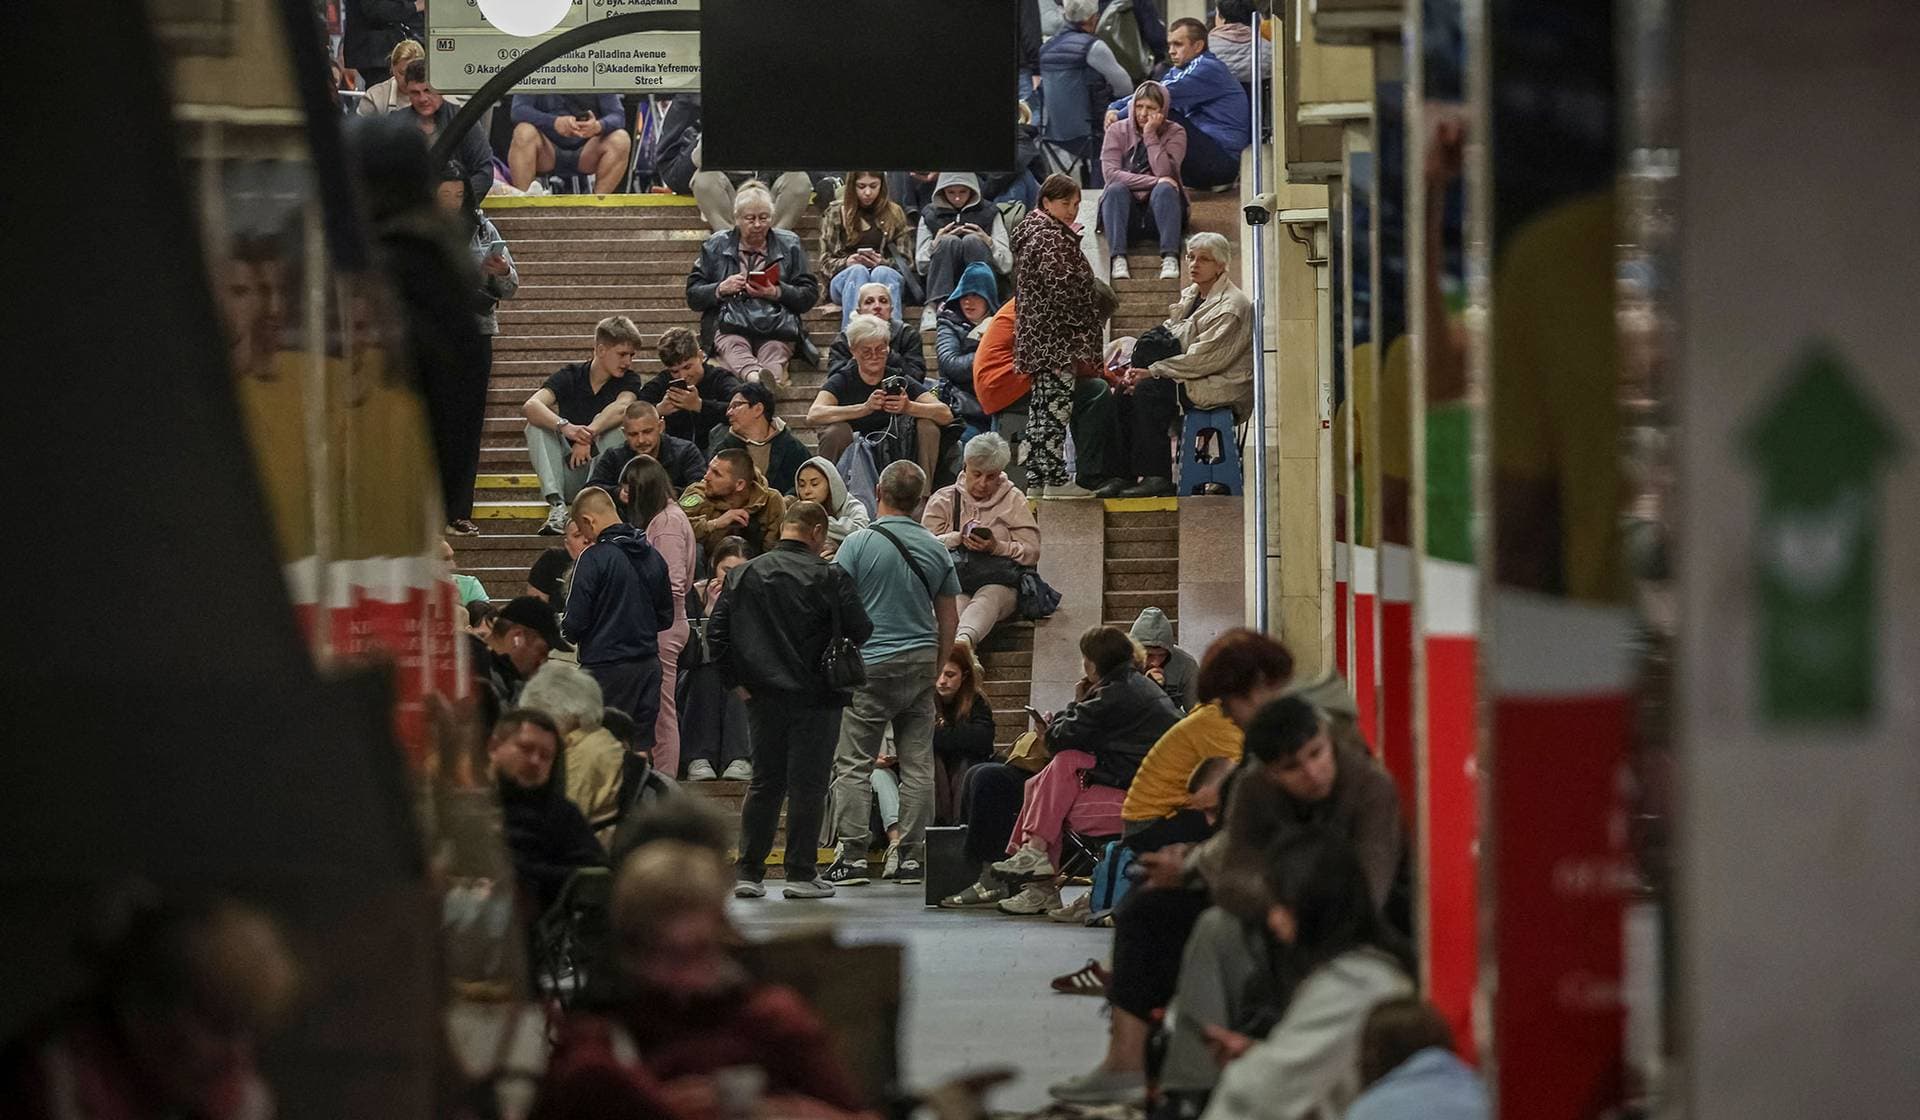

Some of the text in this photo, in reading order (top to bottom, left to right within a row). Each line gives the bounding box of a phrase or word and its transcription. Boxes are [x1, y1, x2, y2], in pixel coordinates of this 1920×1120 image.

[438, 41, 454, 49] M1
[588, 50, 631, 59] Palladina
[633, 50, 667, 59] Avenue
[606, 64, 656, 73] Akademika
[635, 75, 663, 85] Street
